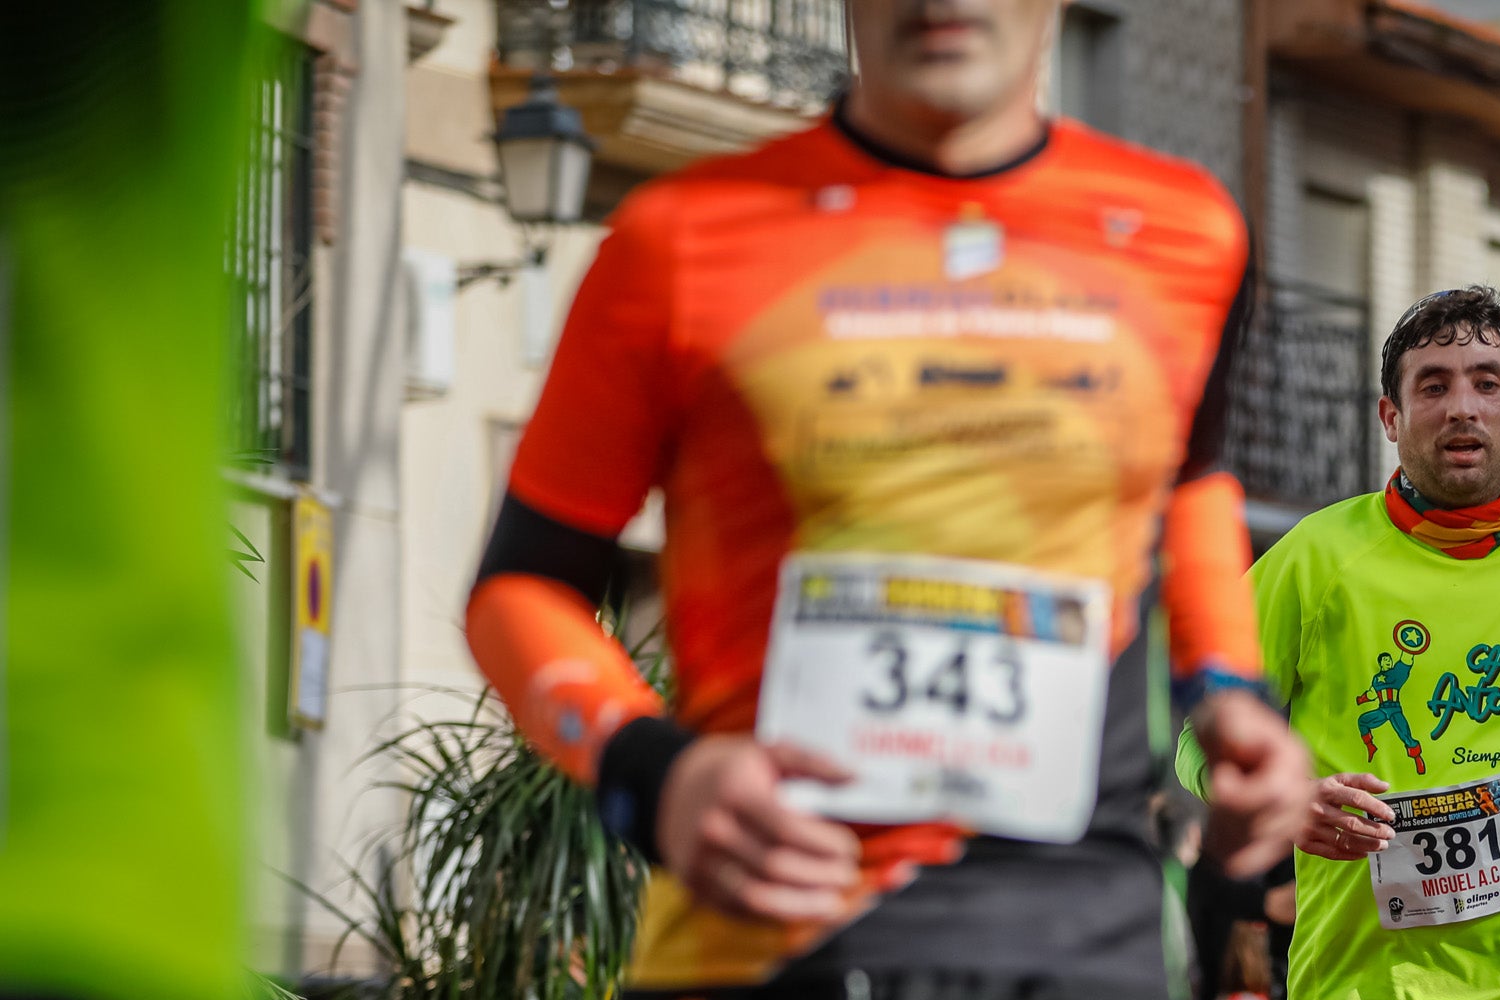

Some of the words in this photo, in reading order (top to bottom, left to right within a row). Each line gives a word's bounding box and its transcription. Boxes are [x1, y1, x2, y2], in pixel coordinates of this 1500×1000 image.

[860, 626, 1027, 725] 343
[1412, 791, 1473, 809] CARRERA
[1414, 801, 1475, 817] POPULAR
[1413, 815, 1447, 826] Secaderos
[1421, 872, 1476, 897] MIGUEL
[1467, 891, 1499, 904] olimpo
